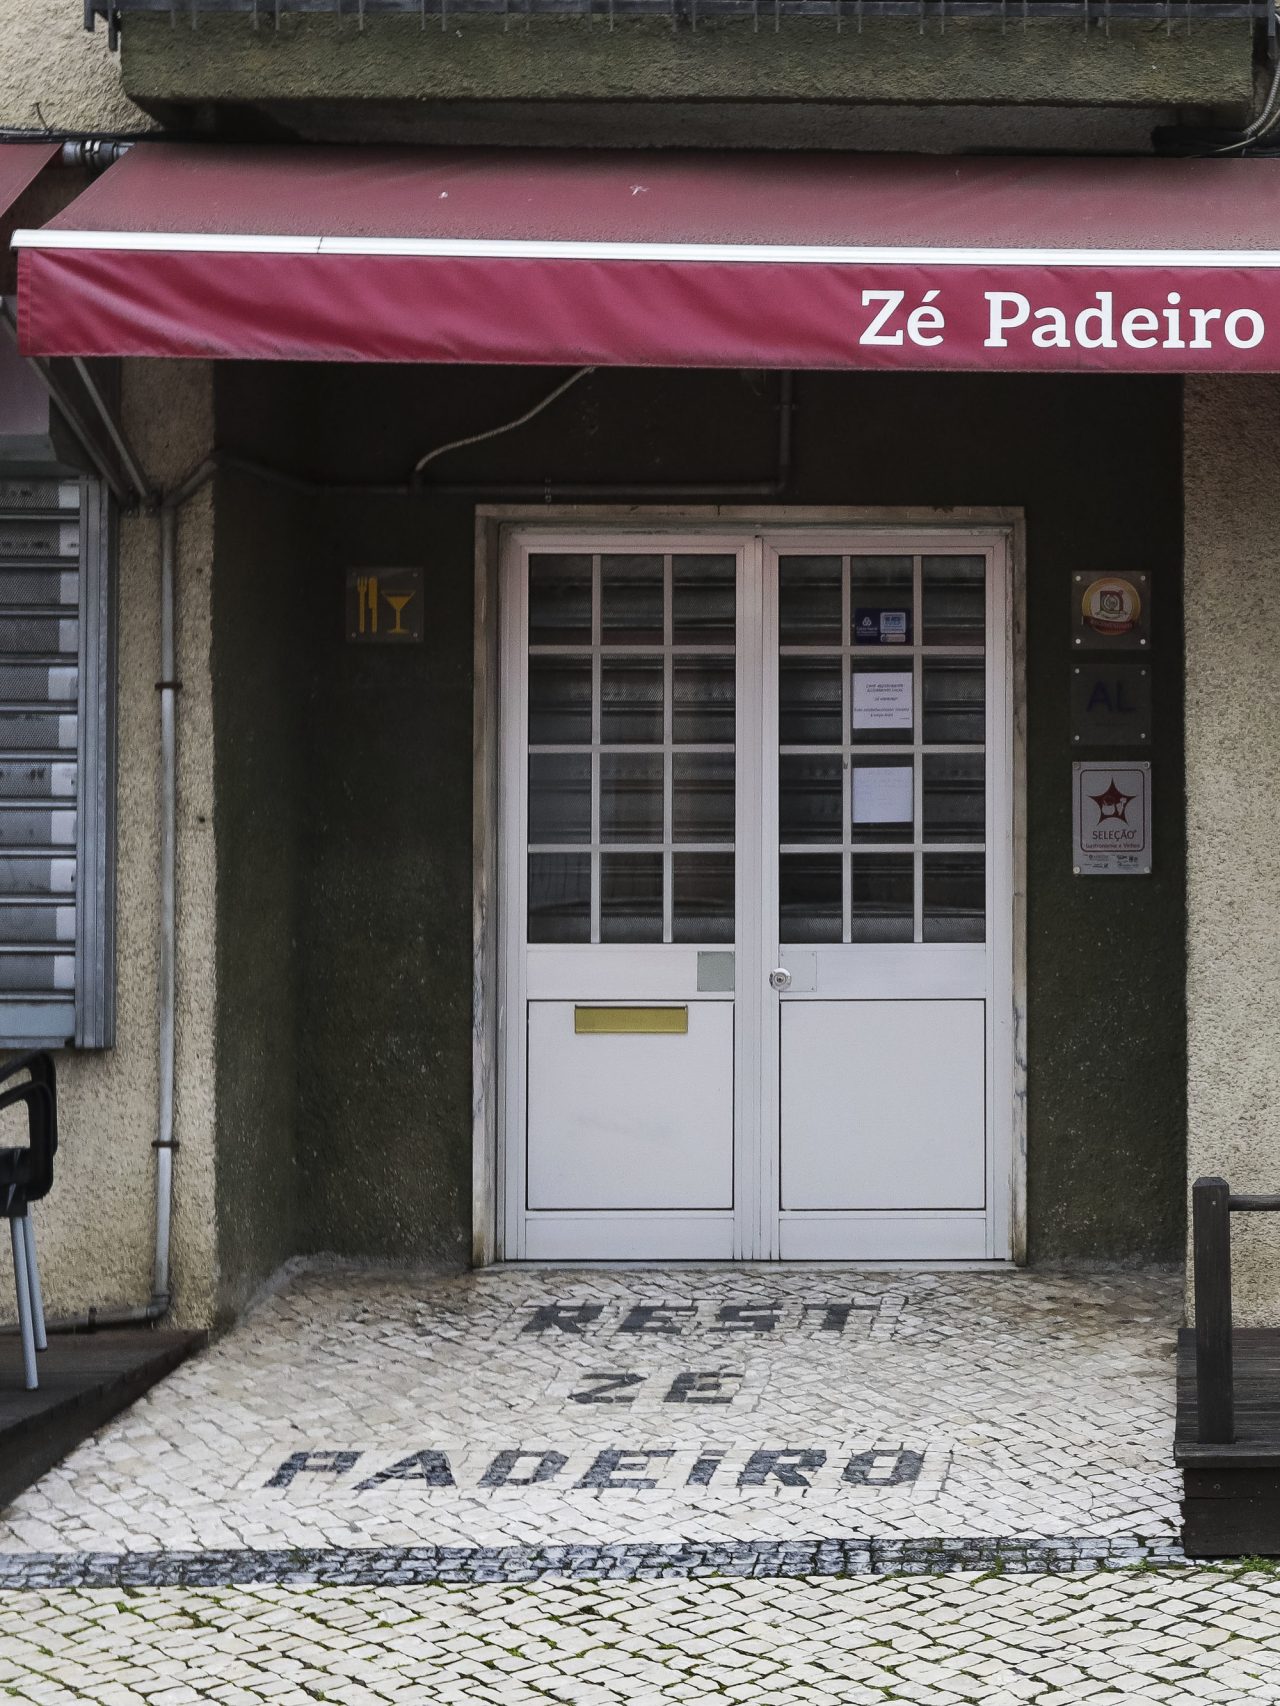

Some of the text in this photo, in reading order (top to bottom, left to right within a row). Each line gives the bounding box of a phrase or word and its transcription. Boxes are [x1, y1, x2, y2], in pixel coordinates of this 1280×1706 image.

[859, 289, 1265, 349] Zé Padeiro
[1086, 680, 1137, 713] AL
[1092, 828, 1136, 842] SELEÇÃO
[522, 1304, 881, 1334] REST
